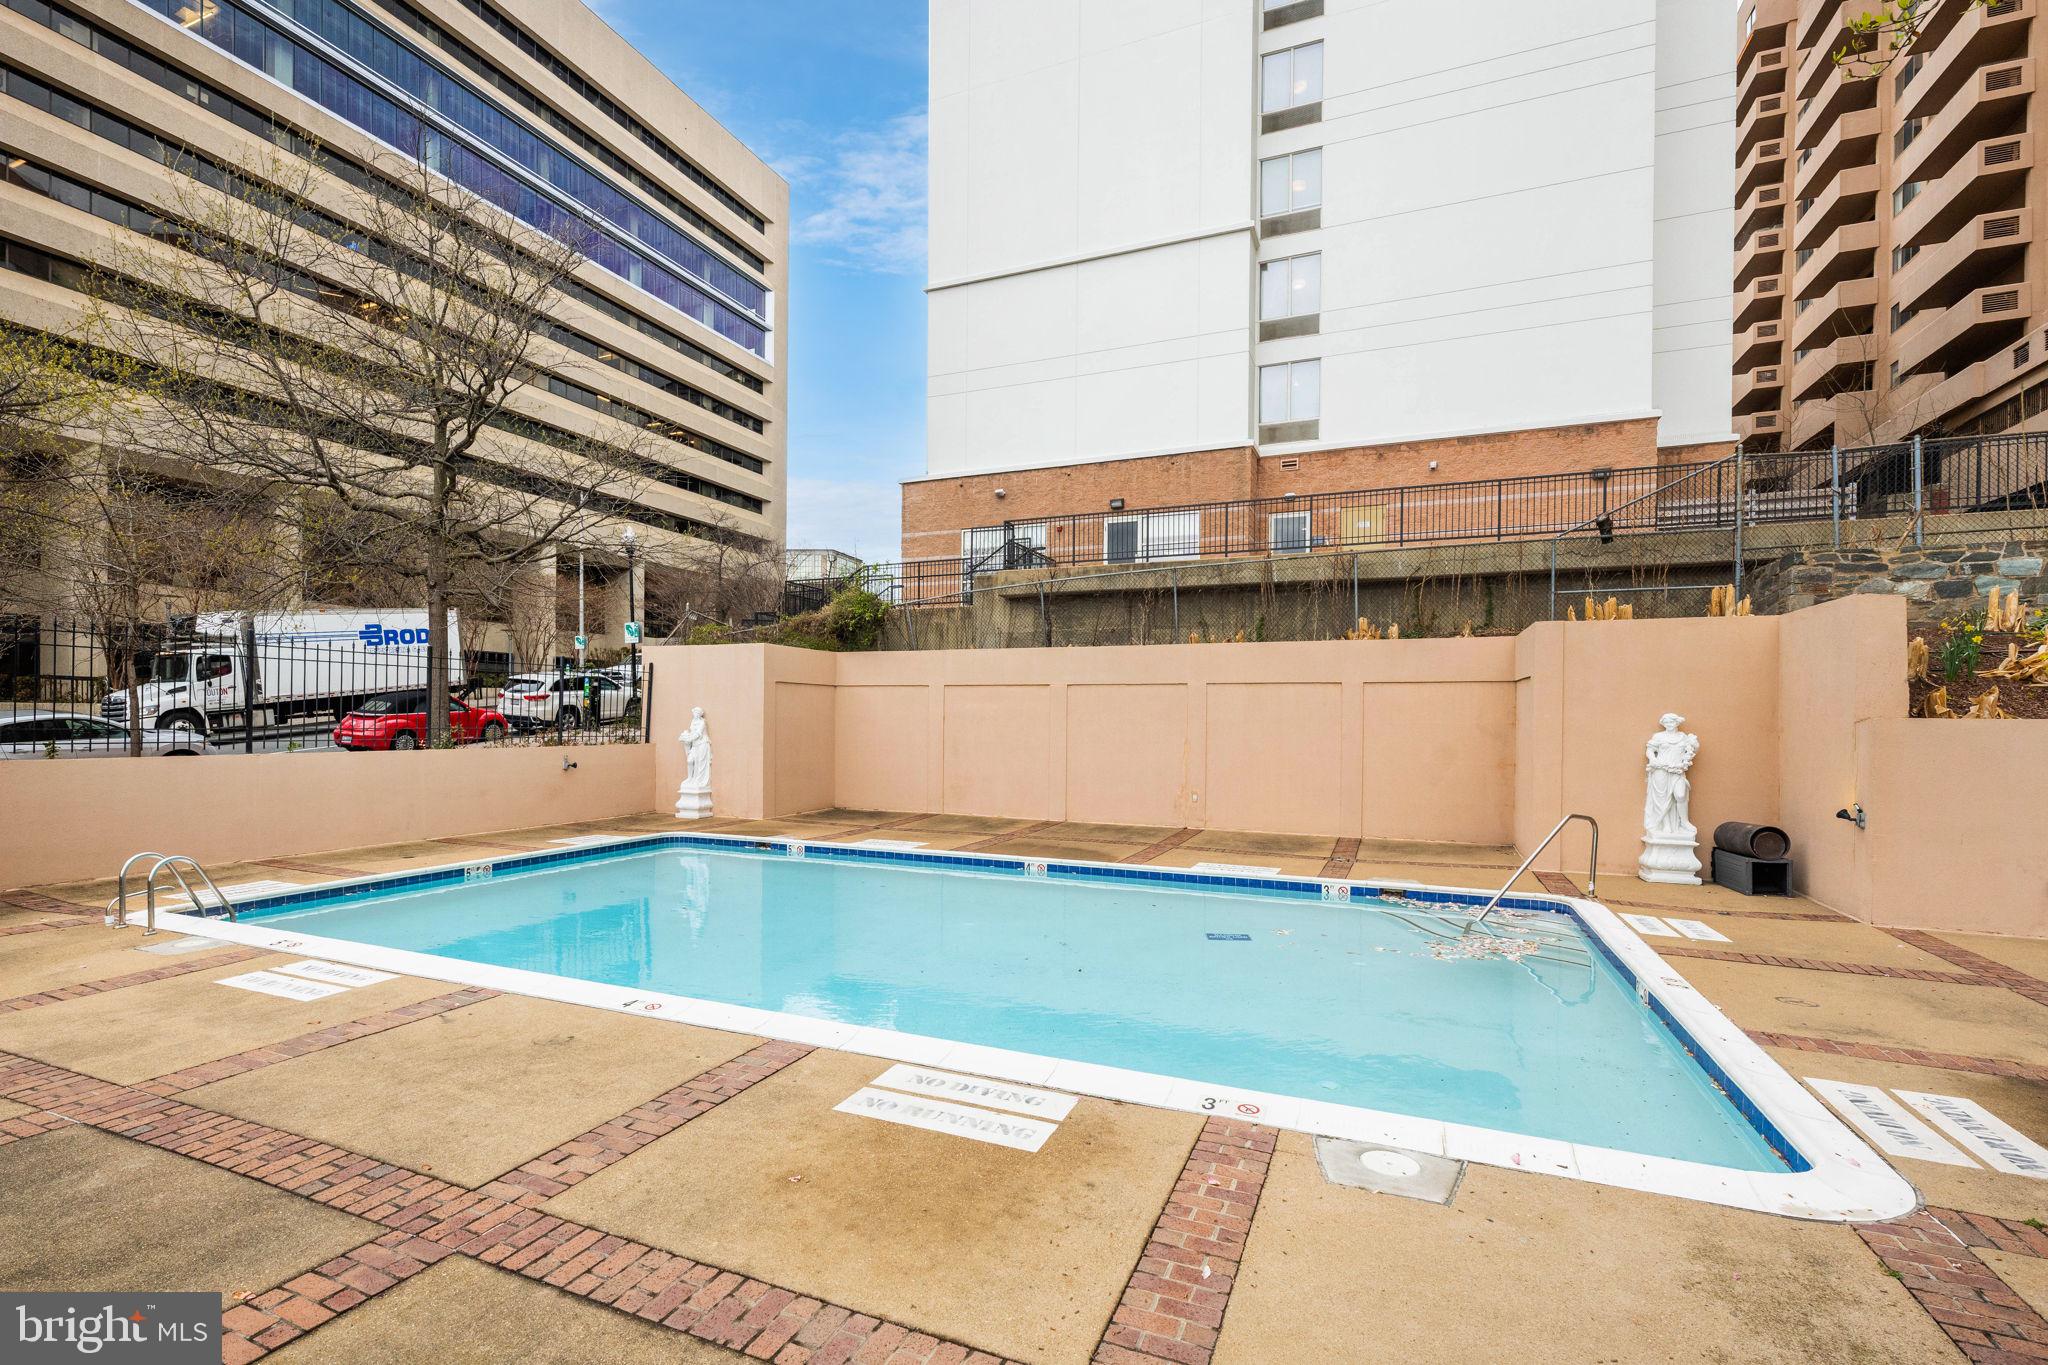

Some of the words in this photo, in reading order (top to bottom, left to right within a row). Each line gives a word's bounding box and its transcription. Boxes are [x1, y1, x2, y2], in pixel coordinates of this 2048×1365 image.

[907, 1073, 946, 1088] NO
[948, 1081, 1046, 1107] DIVING
[1201, 1097, 1217, 1110] 3
[859, 1095, 899, 1111] NO
[899, 1102, 1037, 1140] RUNNING
